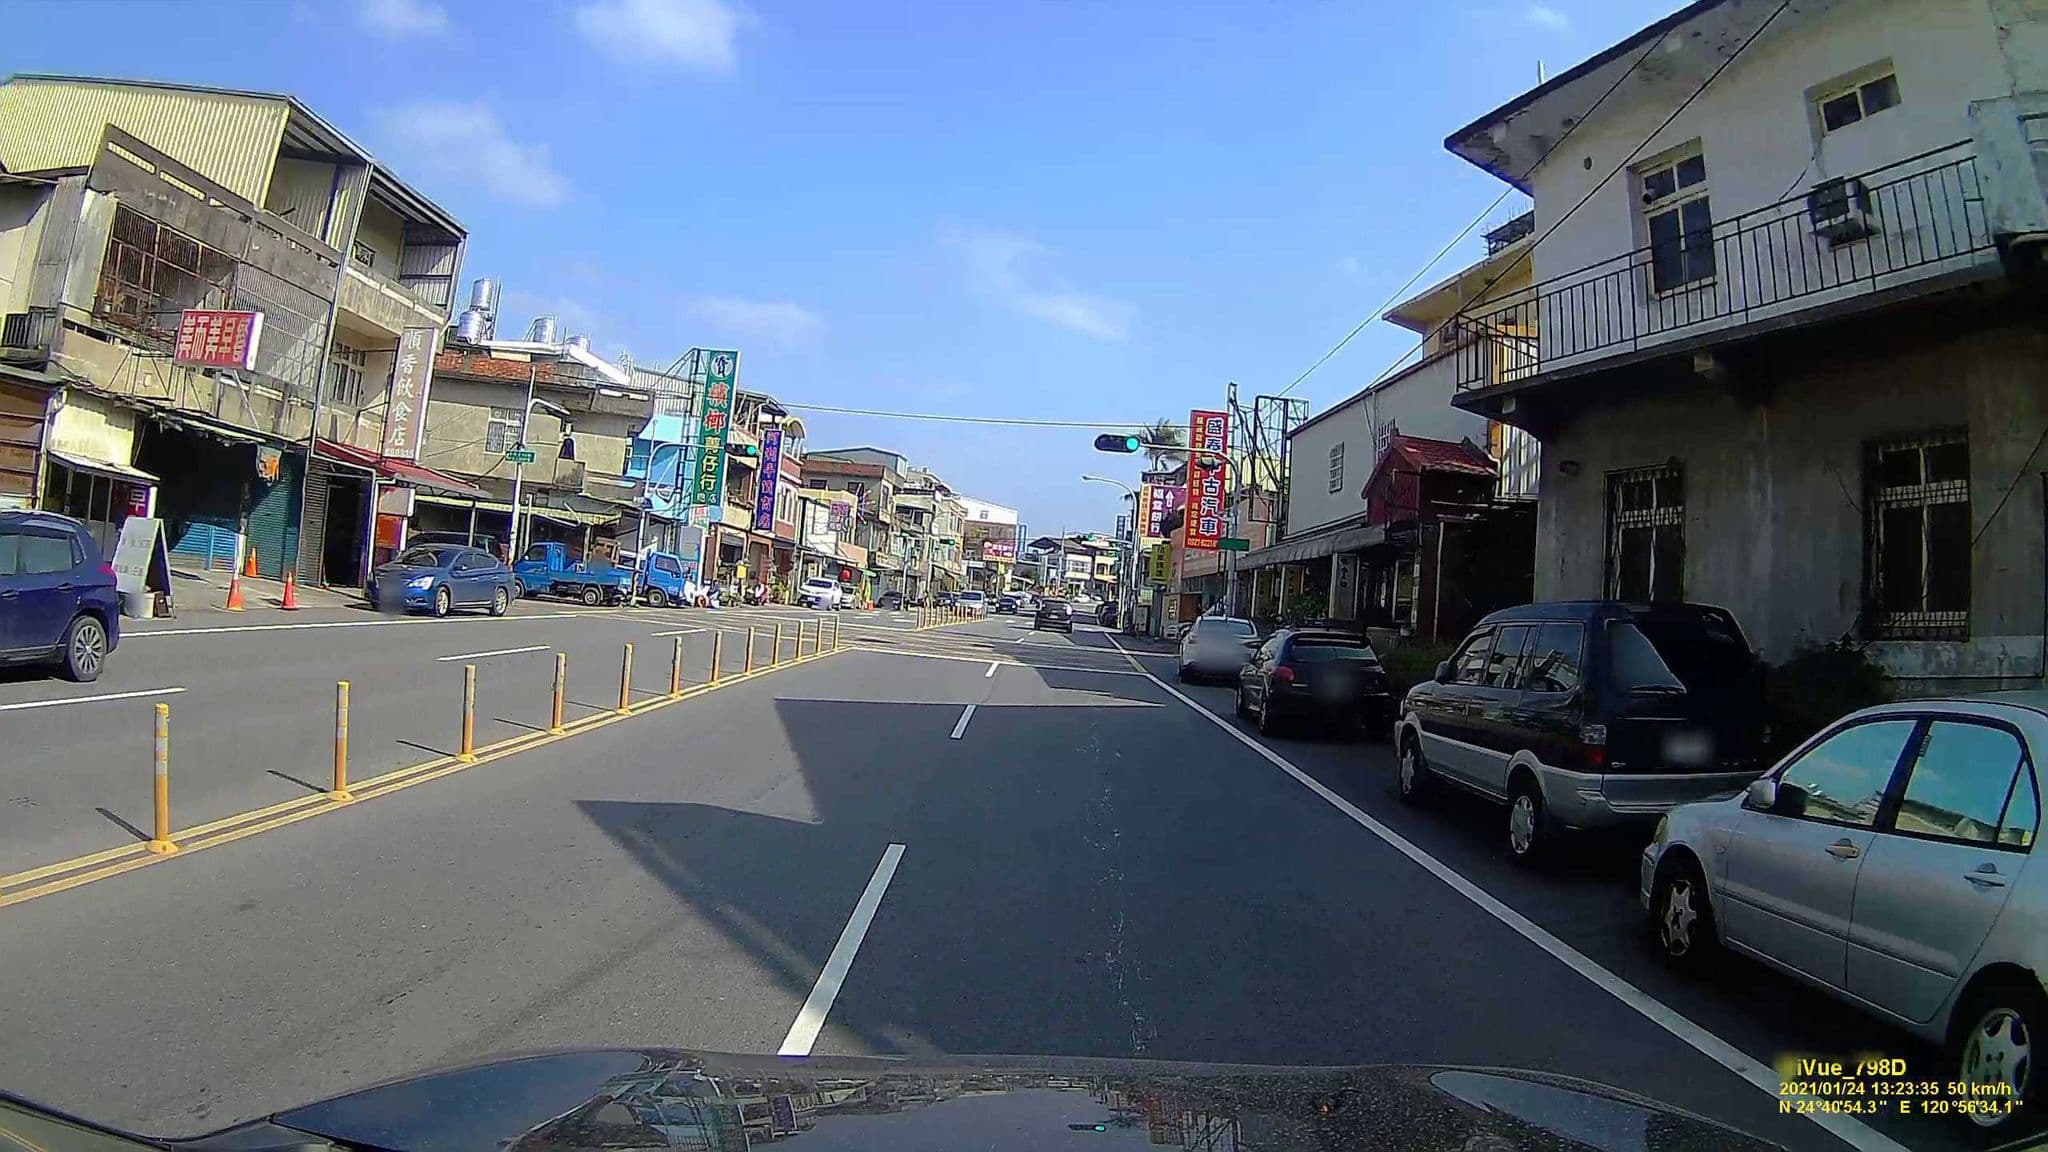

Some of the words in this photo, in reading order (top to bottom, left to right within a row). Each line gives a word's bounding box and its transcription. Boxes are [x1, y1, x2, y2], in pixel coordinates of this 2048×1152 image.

[389, 329, 422, 447] 順香飲食店
